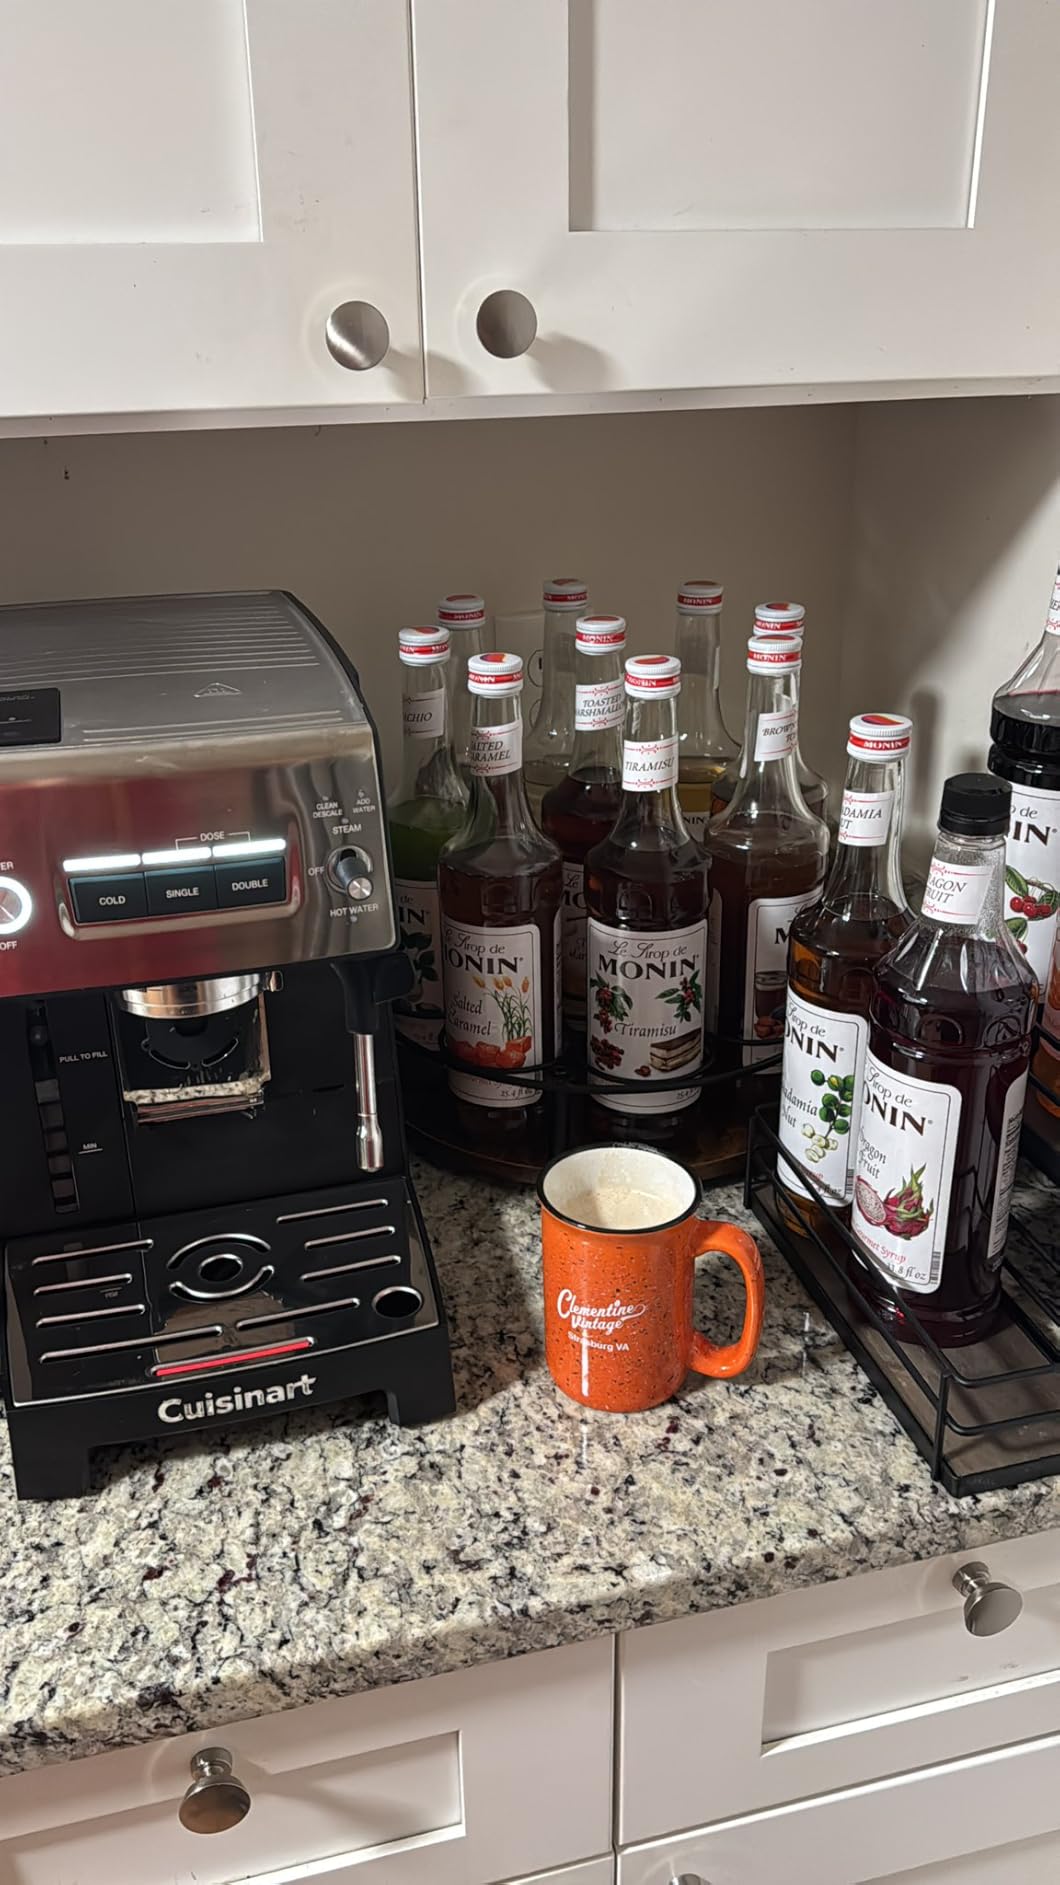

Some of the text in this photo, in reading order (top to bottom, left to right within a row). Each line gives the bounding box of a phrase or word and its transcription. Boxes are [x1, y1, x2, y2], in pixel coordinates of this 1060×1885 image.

[582, 634, 614, 643] MONIN
[753, 653, 787, 662] MONIN
[405, 712, 433, 723] CHIO
[471, 741, 504, 752] ALTED
[863, 740, 903, 750] MONIN
[471, 750, 511, 762] ARAMEL
[624, 757, 674, 773] TIRAMISU
[316, 802, 339, 812] CLEAN
[356, 798, 371, 806] ADD
[312, 808, 343, 819] DESCALE
[352, 805, 376, 814] WATER
[842, 806, 883, 820] DAMIA
[332, 824, 362, 835] STEAM
[840, 818, 854, 830] UT
[200, 831, 225, 842] DOSE
[1012, 821, 1050, 846] IN
[308, 866, 326, 877] OFF
[231, 878, 268, 891] DOUBLE
[929, 876, 967, 893] AGON
[165, 886, 199, 899] SINGLE
[99, 895, 126, 906] COLD
[329, 902, 379, 918] HOT WATER
[489, 944, 506, 954] de
[607, 940, 688, 961] Le Sirop de
[598, 953, 697, 980] MONIN
[613, 1022, 678, 1038] Tiramisu
[810, 1024, 827, 1037] de
[59, 1050, 108, 1064] PULL TO FILL
[782, 1087, 818, 1117] adamia
[894, 1094, 913, 1108] de
[82, 1142, 98, 1151] MIN
[880, 1245, 907, 1264] Syrup
[914, 1271, 928, 1281] oz
[556, 1288, 648, 1319] Clementine
[570, 1314, 624, 1336] Vintage
[567, 1330, 630, 1352] Strsburg VA
[157, 1373, 317, 1424] Cuisinart
